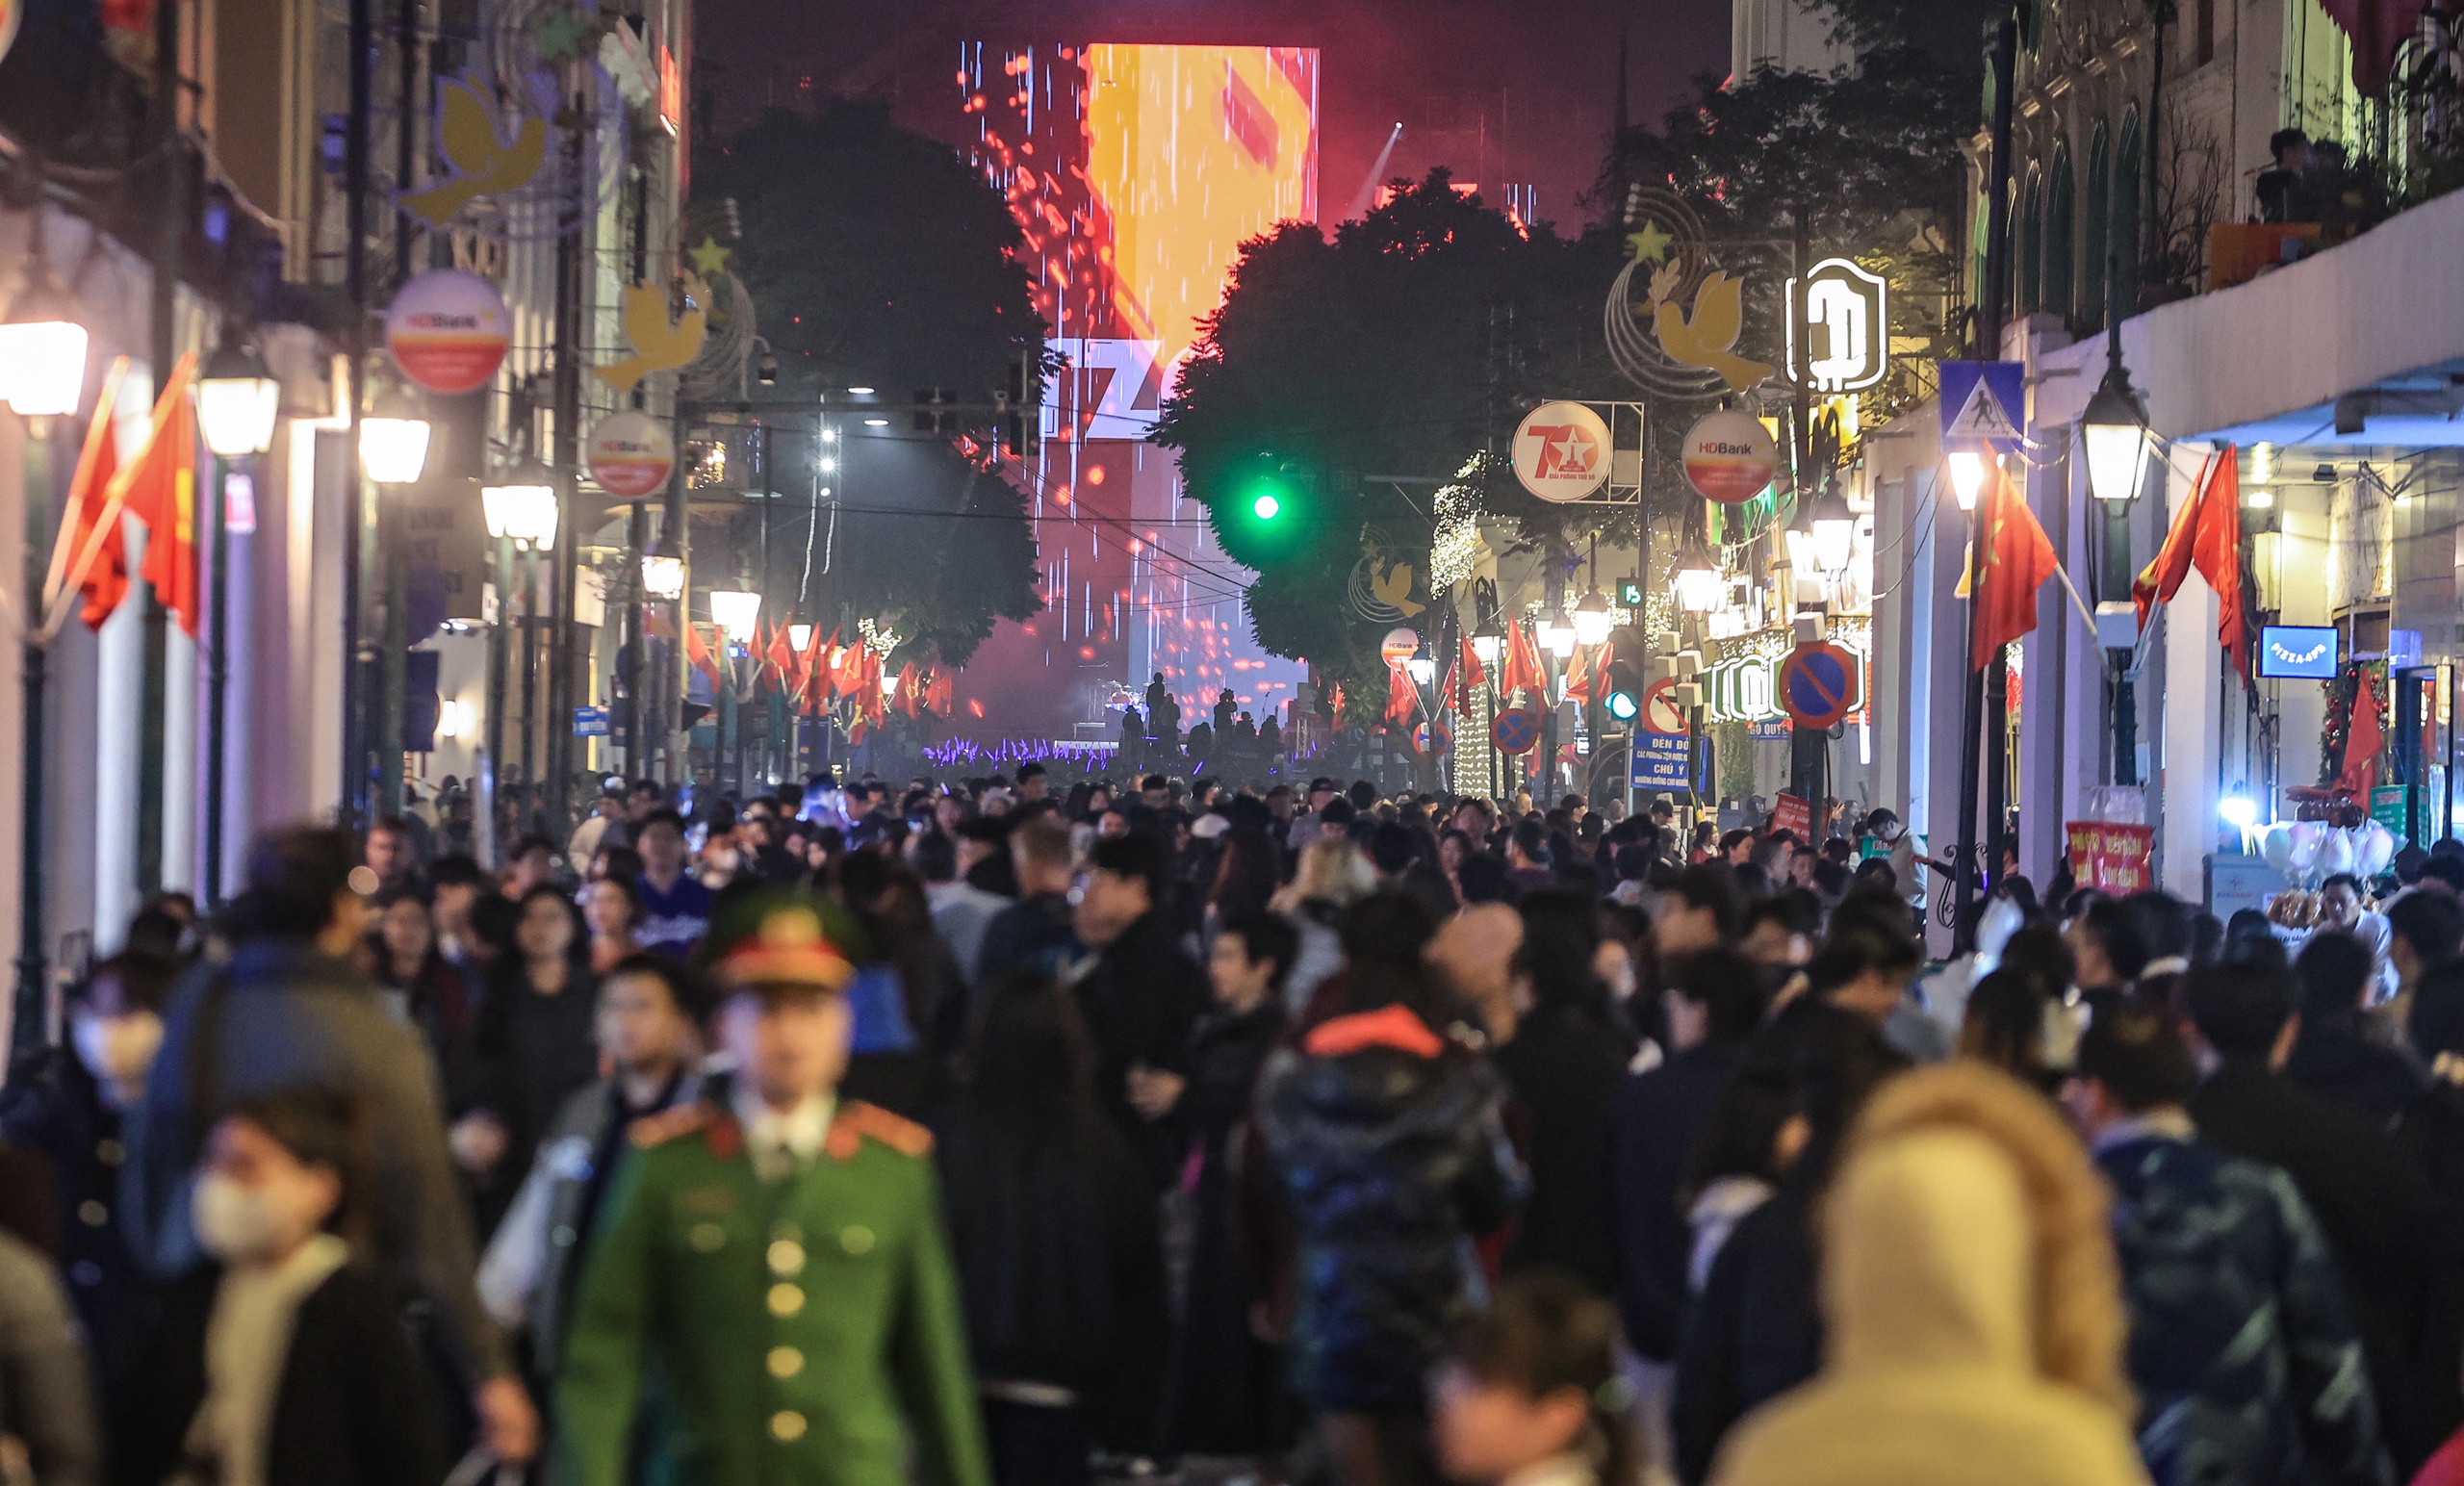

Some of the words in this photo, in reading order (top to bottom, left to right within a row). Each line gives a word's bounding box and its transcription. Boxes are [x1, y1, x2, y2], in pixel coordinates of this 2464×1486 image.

[1699, 442, 1752, 455] HDBank
[1654, 762, 1674, 775] CHÚ
[1678, 763, 1685, 776] Ý
